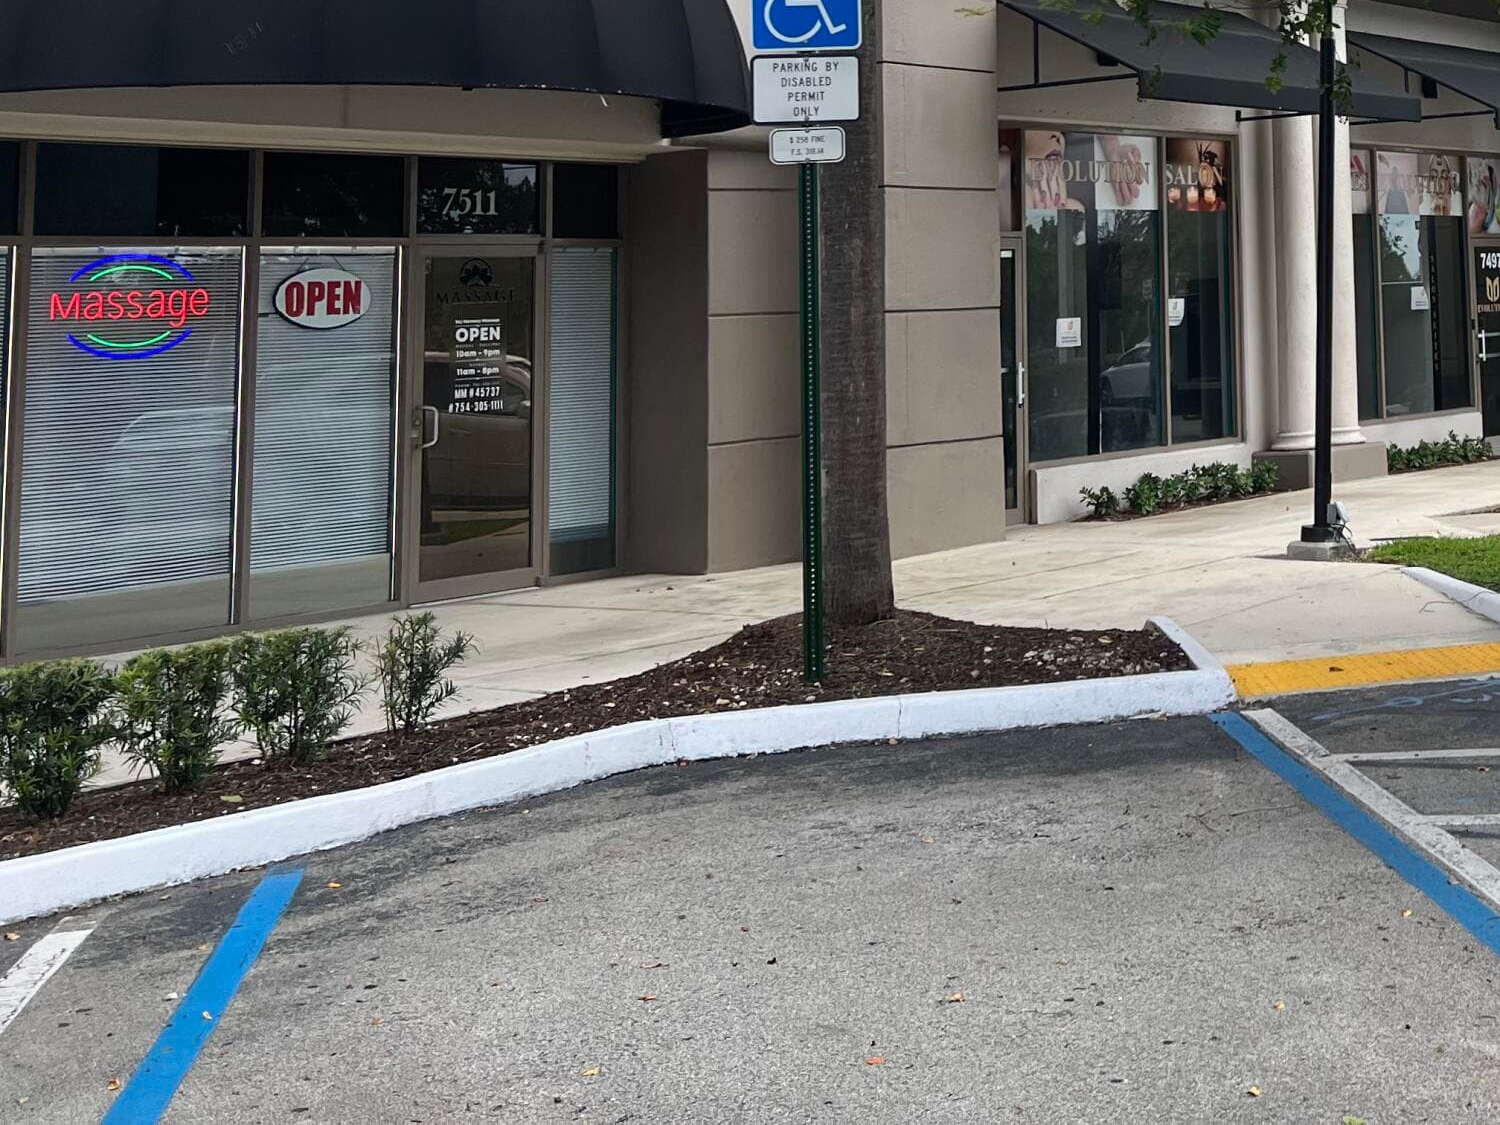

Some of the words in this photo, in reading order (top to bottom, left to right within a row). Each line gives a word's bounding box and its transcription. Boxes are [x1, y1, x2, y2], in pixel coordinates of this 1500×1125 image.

[772, 61, 818, 73] PARKING
[825, 61, 840, 72] BY
[781, 76, 832, 87] DISABLED
[787, 91, 825, 102] PERMIT
[793, 106, 820, 117] ONLY
[1027, 158, 1151, 185] EVOLUTION
[1165, 161, 1225, 188] SALON
[442, 187, 499, 215] 7511
[284, 280, 363, 318] OPEN
[49, 288, 209, 328] Massage
[455, 327, 500, 342] OPEN
[456, 368, 476, 376] 11am
